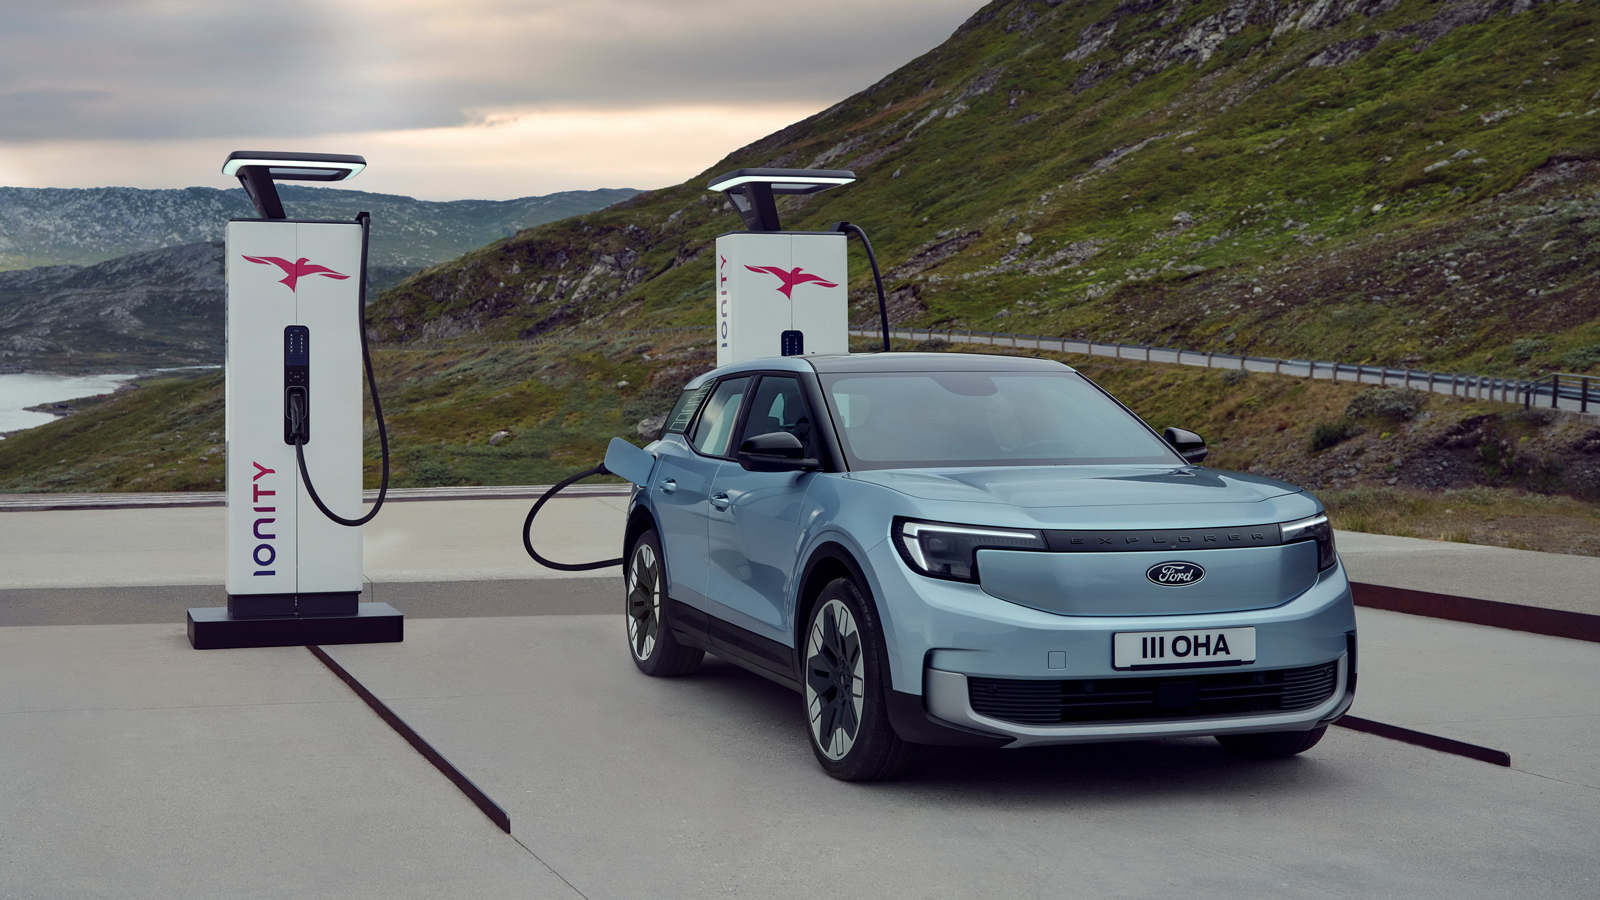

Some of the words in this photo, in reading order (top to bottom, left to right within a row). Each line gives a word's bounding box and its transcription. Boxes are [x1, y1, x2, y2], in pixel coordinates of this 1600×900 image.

[720, 254, 728, 348] IONITY
[253, 461, 276, 576] IONITY
[1069, 532, 1265, 545] EXPLORER
[1159, 564, 1194, 582] Ford
[1171, 633, 1231, 658] OHA
